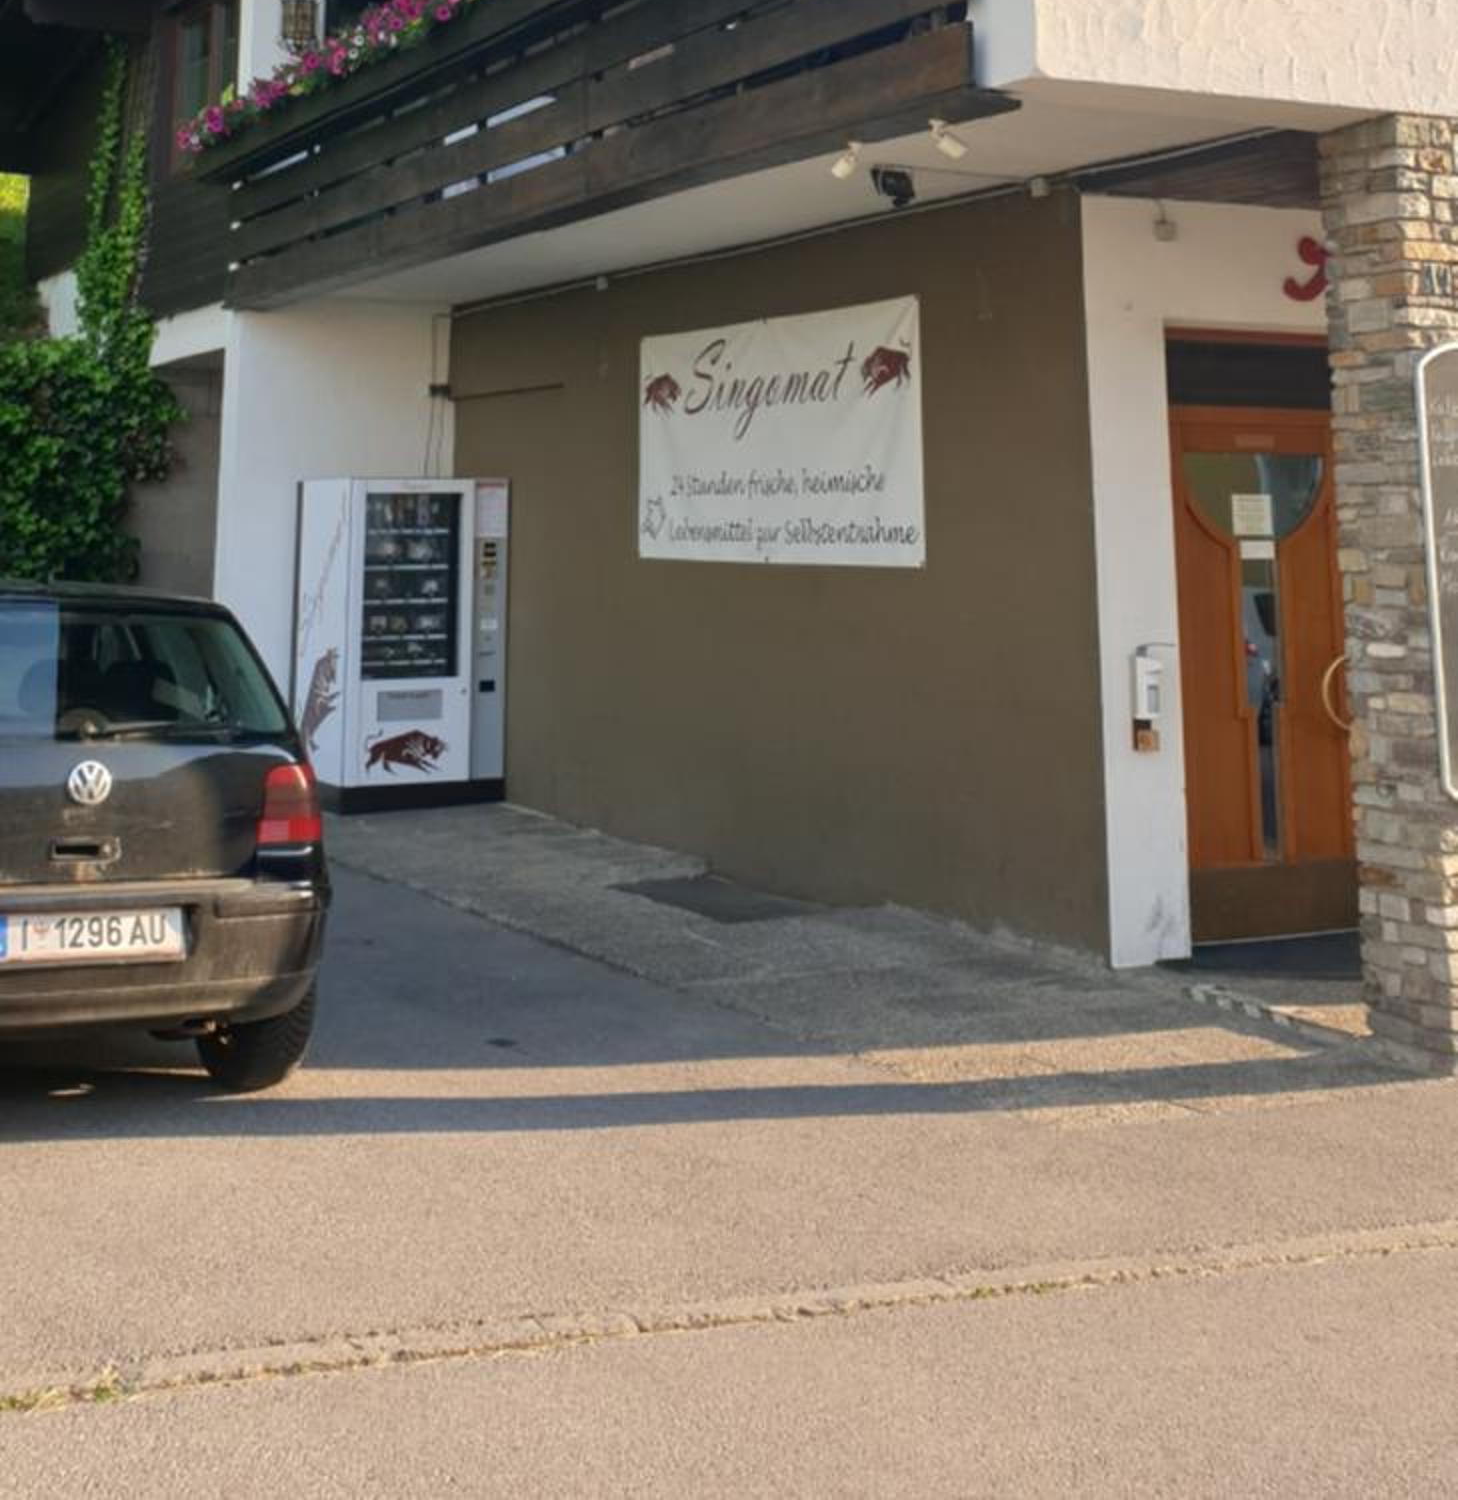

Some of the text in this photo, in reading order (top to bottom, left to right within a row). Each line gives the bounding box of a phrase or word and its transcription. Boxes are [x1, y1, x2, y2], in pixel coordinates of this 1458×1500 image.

[684, 338, 856, 440] Singomat
[801, 464, 886, 498] heimische
[668, 515, 921, 551] Lebensmittel zur Selbstentnahme
[54, 915, 123, 949] 1296
[129, 912, 167, 946] AU
